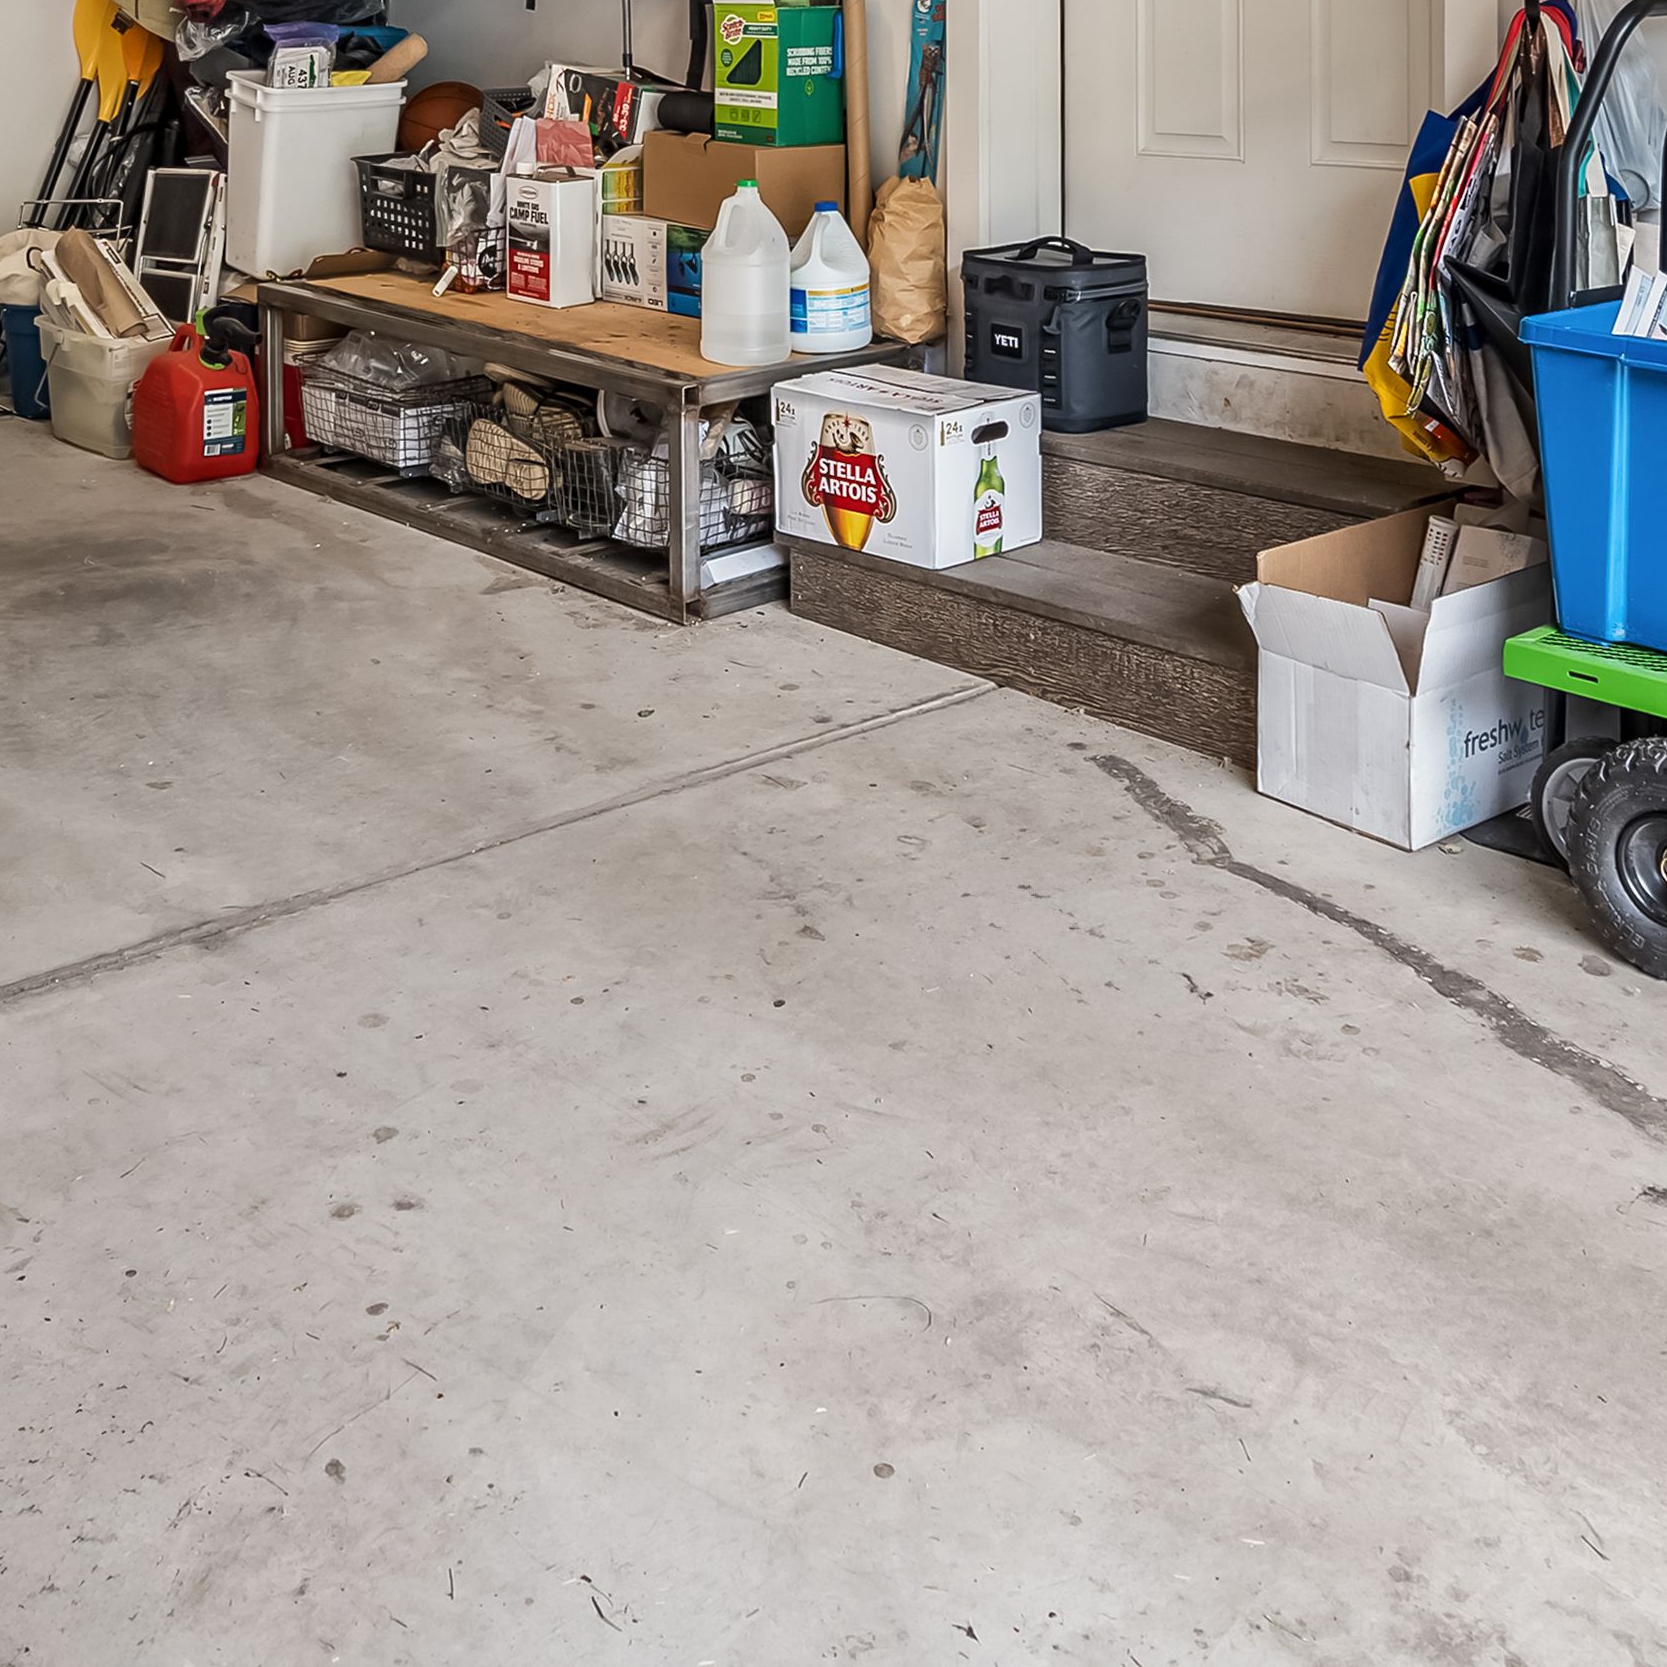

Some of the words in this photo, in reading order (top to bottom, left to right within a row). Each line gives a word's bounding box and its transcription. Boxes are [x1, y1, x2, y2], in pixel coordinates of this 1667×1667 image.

[722, 19, 744, 33] Scotch
[788, 57, 802, 66] MADE
[803, 57, 817, 65] FROM
[786, 67, 810, 76] RECYCLED
[509, 206, 530, 221] CAMP
[530, 211, 549, 224] FUEL
[994, 333, 1019, 348] YETI
[819, 458, 876, 485] STELLA
[819, 477, 877, 504] ARTOIS
[979, 518, 1000, 529] ARTOIS
[980, 511, 1000, 522] STELLA
[1498, 749, 1512, 764] Salt
